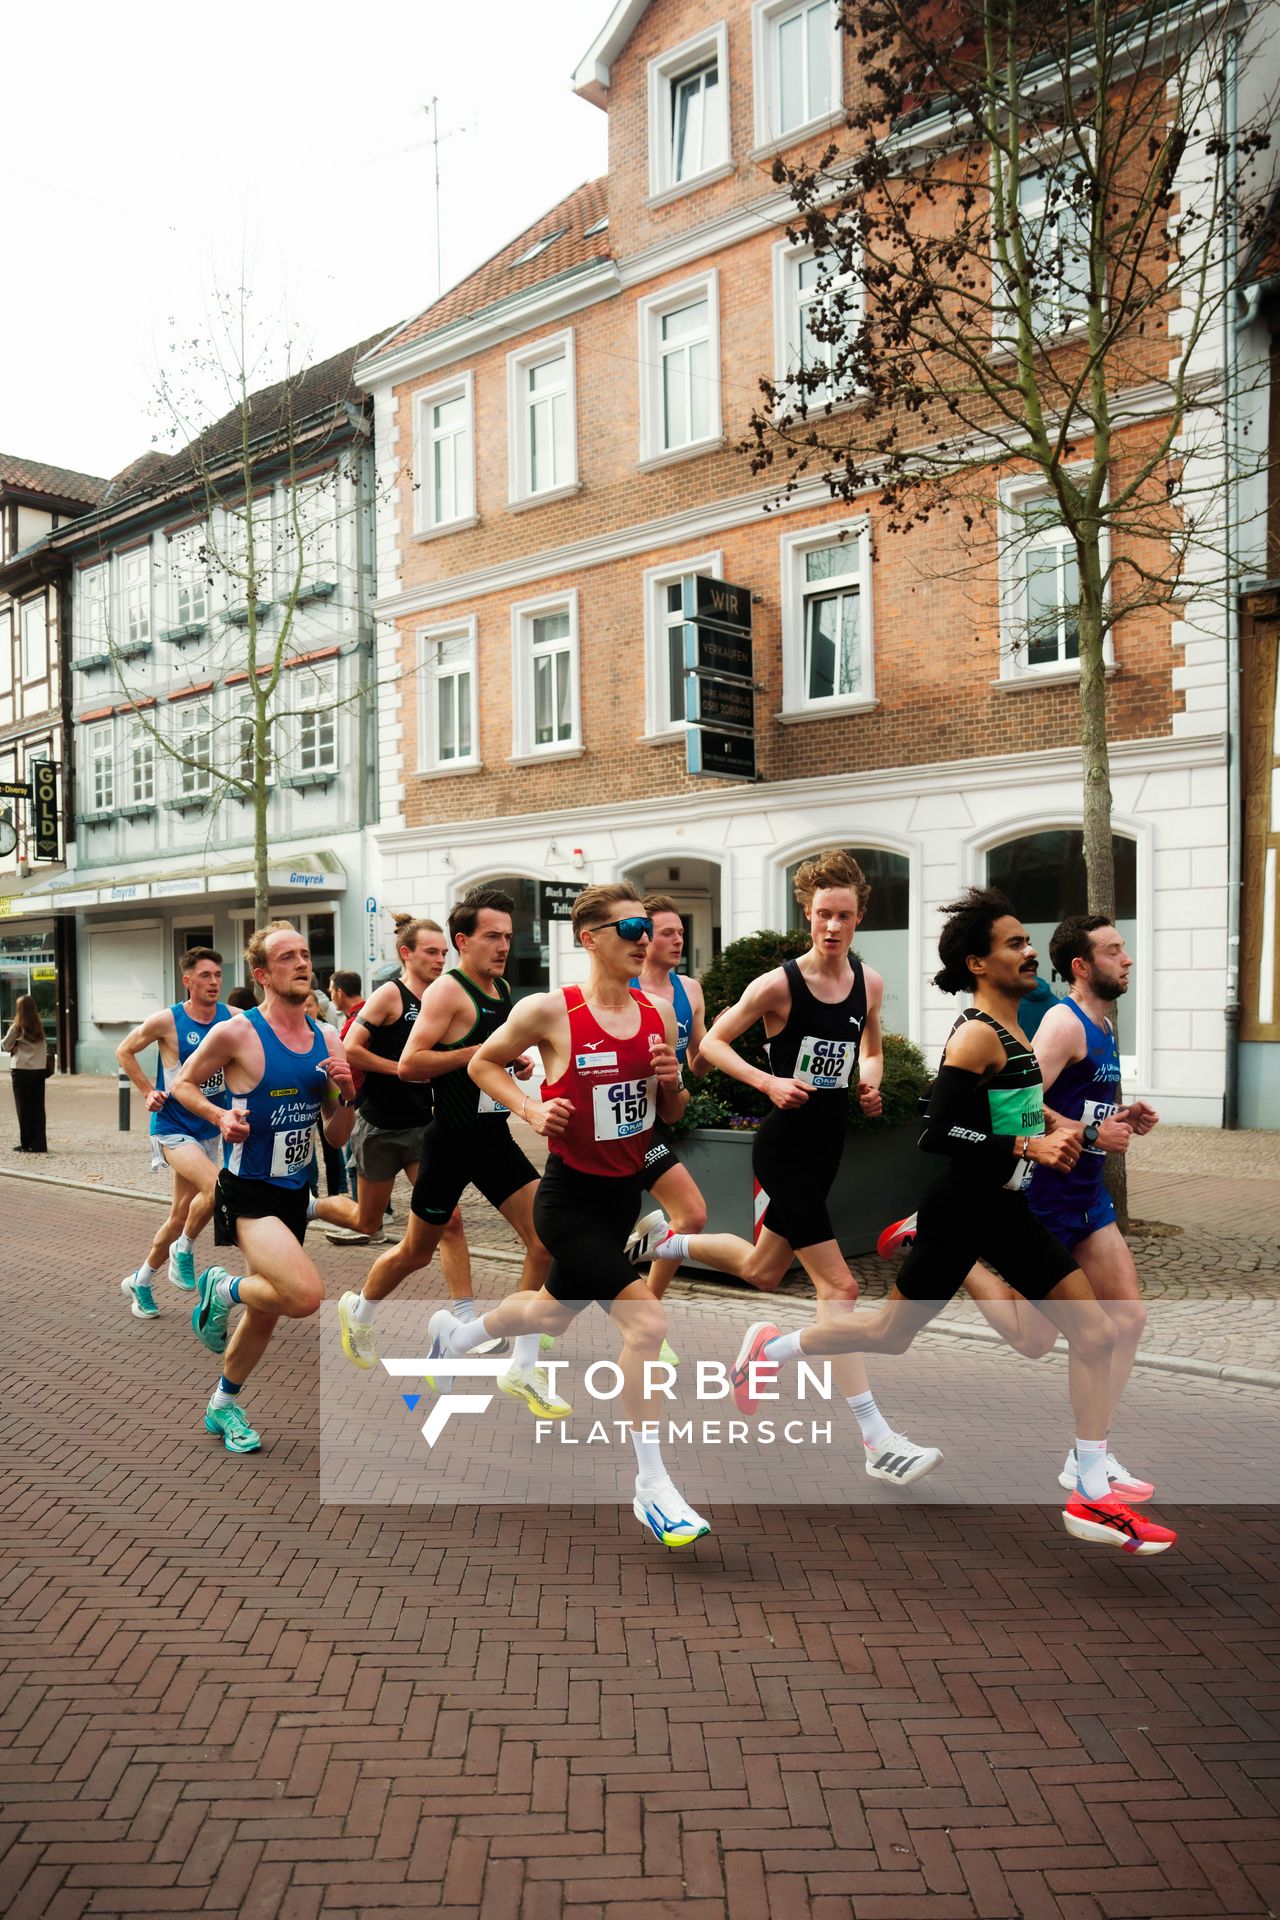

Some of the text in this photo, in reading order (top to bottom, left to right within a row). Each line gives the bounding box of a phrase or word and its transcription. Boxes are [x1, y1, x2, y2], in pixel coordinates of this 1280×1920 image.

[711, 589, 739, 615] WIR
[703, 641, 748, 662] VERKAUFEN
[39, 767, 55, 836] GOLD
[290, 872, 324, 886] Gmyrek
[111, 885, 136, 900] Gmyrek
[813, 1041, 846, 1058] GLS
[810, 1057, 845, 1077] 802
[608, 1080, 647, 1103] GLS
[288, 1102, 306, 1111] LAV
[612, 1098, 648, 1124] 150
[285, 1128, 311, 1146] GLS
[962, 1129, 987, 1143] cep
[285, 1142, 310, 1164] 928
[644, 1144, 666, 1161] CTIVE
[524, 1384, 551, 1410] BROOKS
